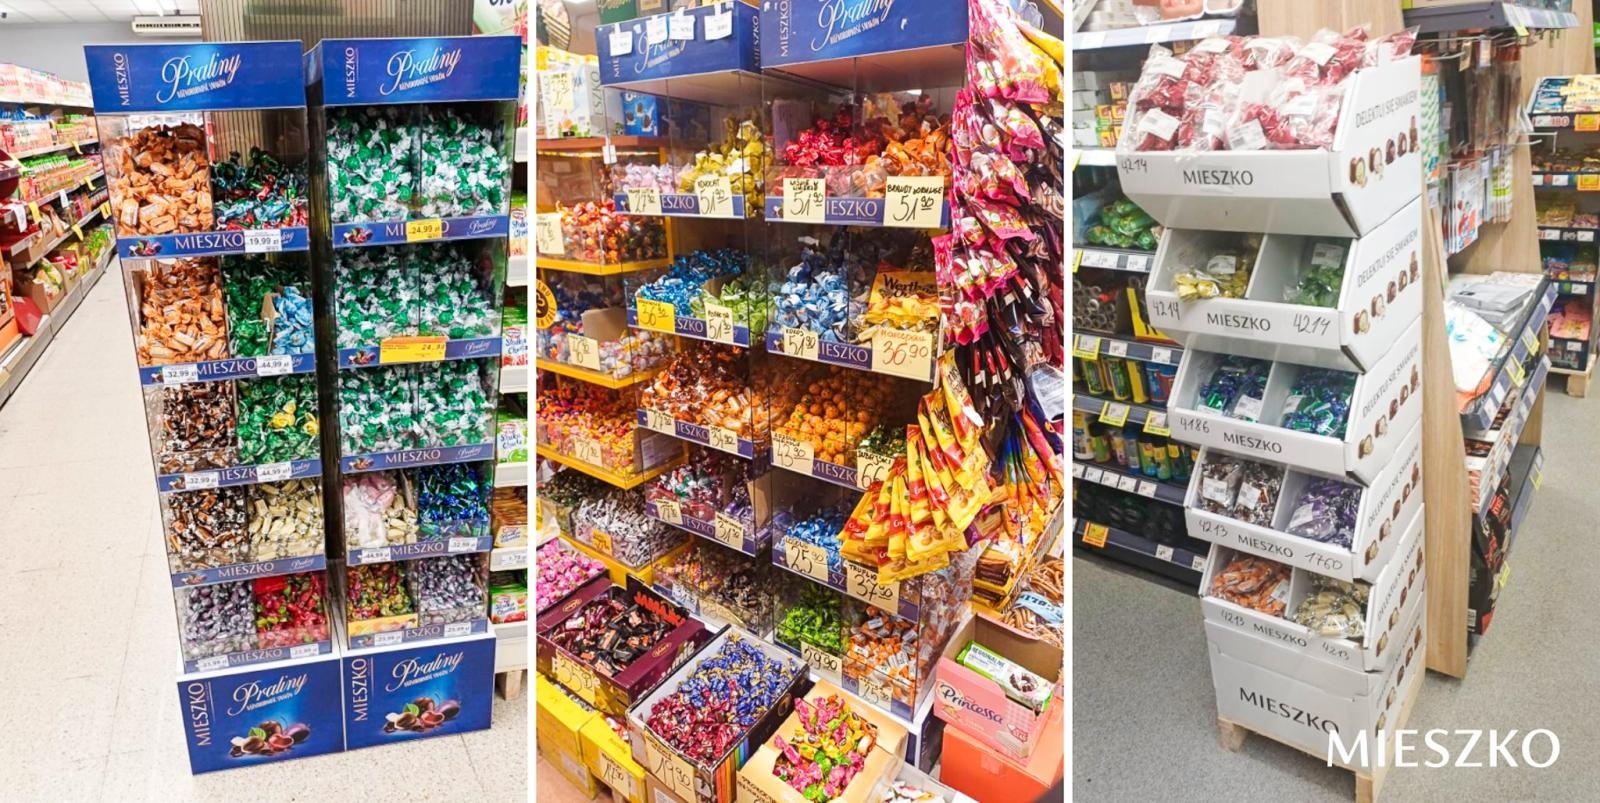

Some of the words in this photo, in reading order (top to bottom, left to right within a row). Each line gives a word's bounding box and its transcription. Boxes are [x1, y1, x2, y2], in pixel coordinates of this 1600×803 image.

[779, 0, 789, 57] MIESZKO
[811, 0, 895, 51] Praliny
[113, 53, 130, 106] MIESZKO
[156, 53, 241, 104] Praliny
[345, 47, 356, 98] MIESZKO
[379, 47, 462, 96] Praliny
[1121, 158, 1148, 175] 4214
[1183, 169, 1254, 186] MIESZKO
[662, 196, 695, 209] ESZKO
[790, 191, 811, 216] 51
[826, 200, 878, 217] IESZKO
[892, 194, 918, 222] 51
[175, 233, 245, 250] MIESZKO
[1152, 300, 1180, 321] 4214
[675, 318, 704, 333] SZKO
[785, 328, 804, 337] KOKOS
[1206, 312, 1271, 332] MIESZKO
[1293, 313, 1331, 337] 4214
[820, 345, 868, 363] IESZKO
[882, 340, 907, 365] 36
[908, 344, 929, 358] 90
[197, 360, 256, 376] MIESZKO
[677, 423, 710, 440] IESZKO
[1223, 431, 1282, 454] MIESZKO
[385, 449, 441, 464] MIESZKO
[220, 468, 257, 482] IESZK
[683, 517, 714, 534] IESZKO
[1198, 519, 1228, 538] 4213
[391, 542, 444, 556] MIESZKO
[1237, 534, 1294, 558] MIESZKO
[218, 562, 275, 578] MIESZKO
[790, 545, 813, 574] 25
[1304, 551, 1343, 571] 1760
[854, 573, 878, 601] 37
[1220, 609, 1245, 627] 4213
[1253, 623, 1308, 648] MIESZKO
[229, 649, 283, 665] MIESZKO
[385, 651, 464, 693] Praliny
[227, 673, 308, 717] Praliny
[351, 658, 368, 721] MIESZKO
[188, 682, 212, 746] MIESZKO
[940, 683, 1003, 725] Princessa
[1239, 686, 1340, 736] MIESZKO
